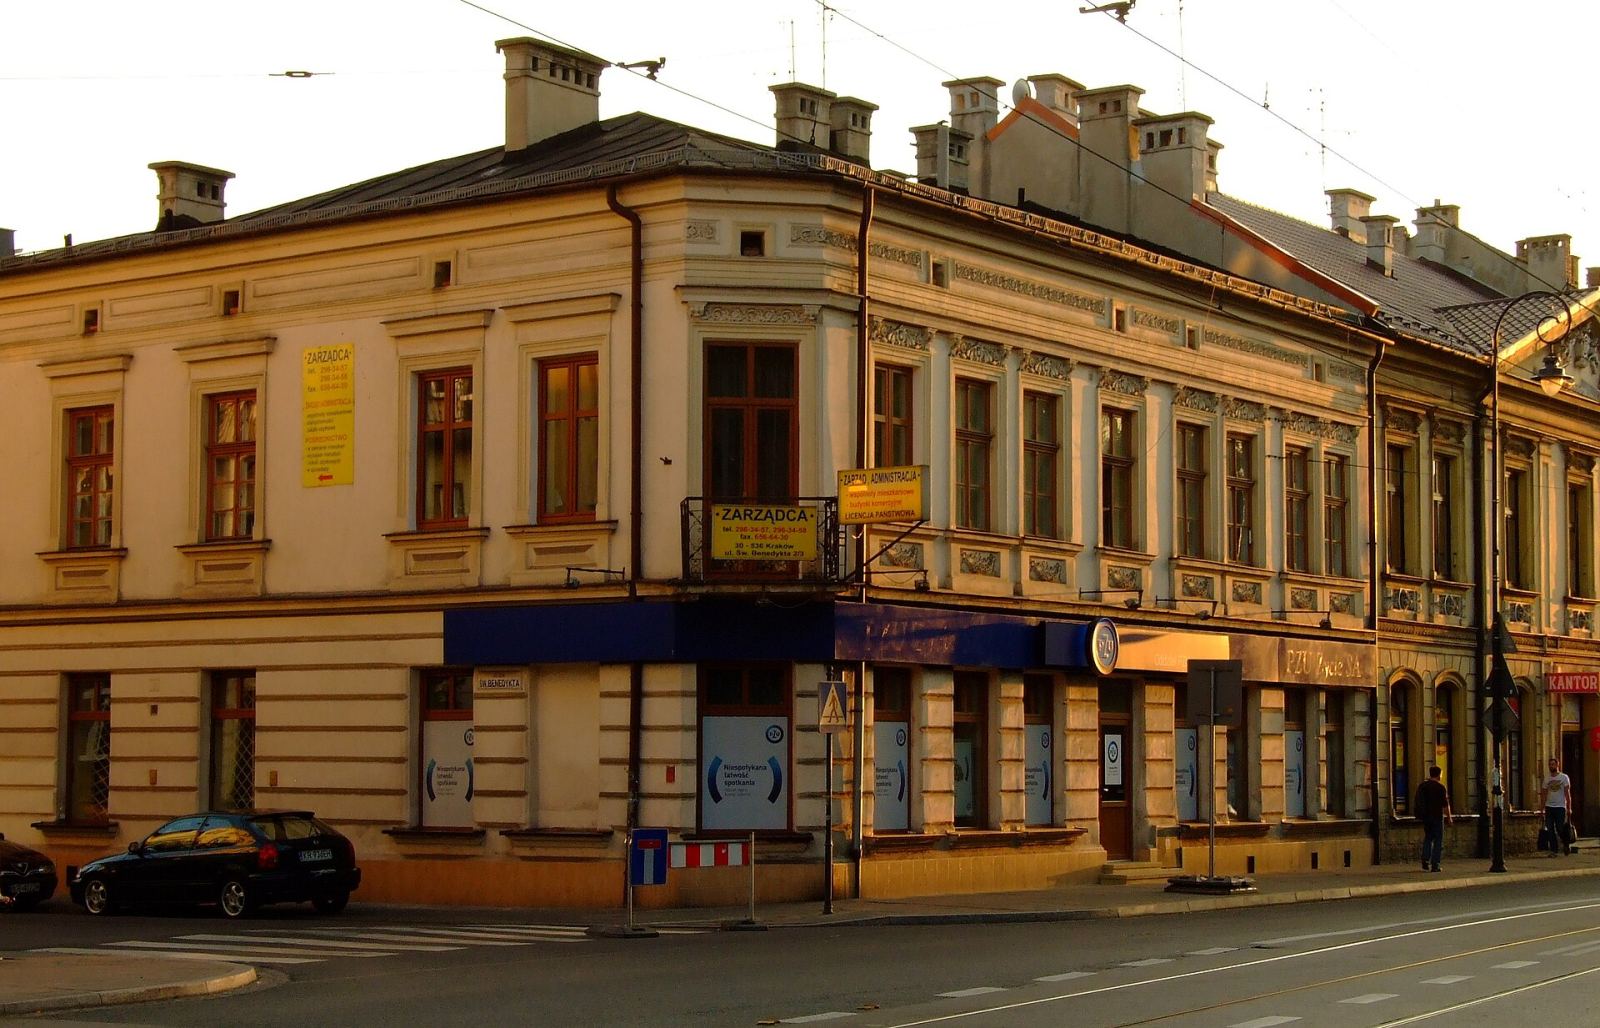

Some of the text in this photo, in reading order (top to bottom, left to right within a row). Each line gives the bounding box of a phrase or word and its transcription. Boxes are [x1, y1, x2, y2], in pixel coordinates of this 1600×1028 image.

[308, 349, 349, 364] ZARZĄDCA
[871, 470, 917, 484] ADMINISTRACJA
[722, 507, 808, 525] ZARZĄDCA
[845, 511, 874, 520] LICENCJA
[751, 550, 791, 558] Benedykta
[1286, 649, 1312, 674] PZU
[1549, 675, 1598, 690] KANTOR
